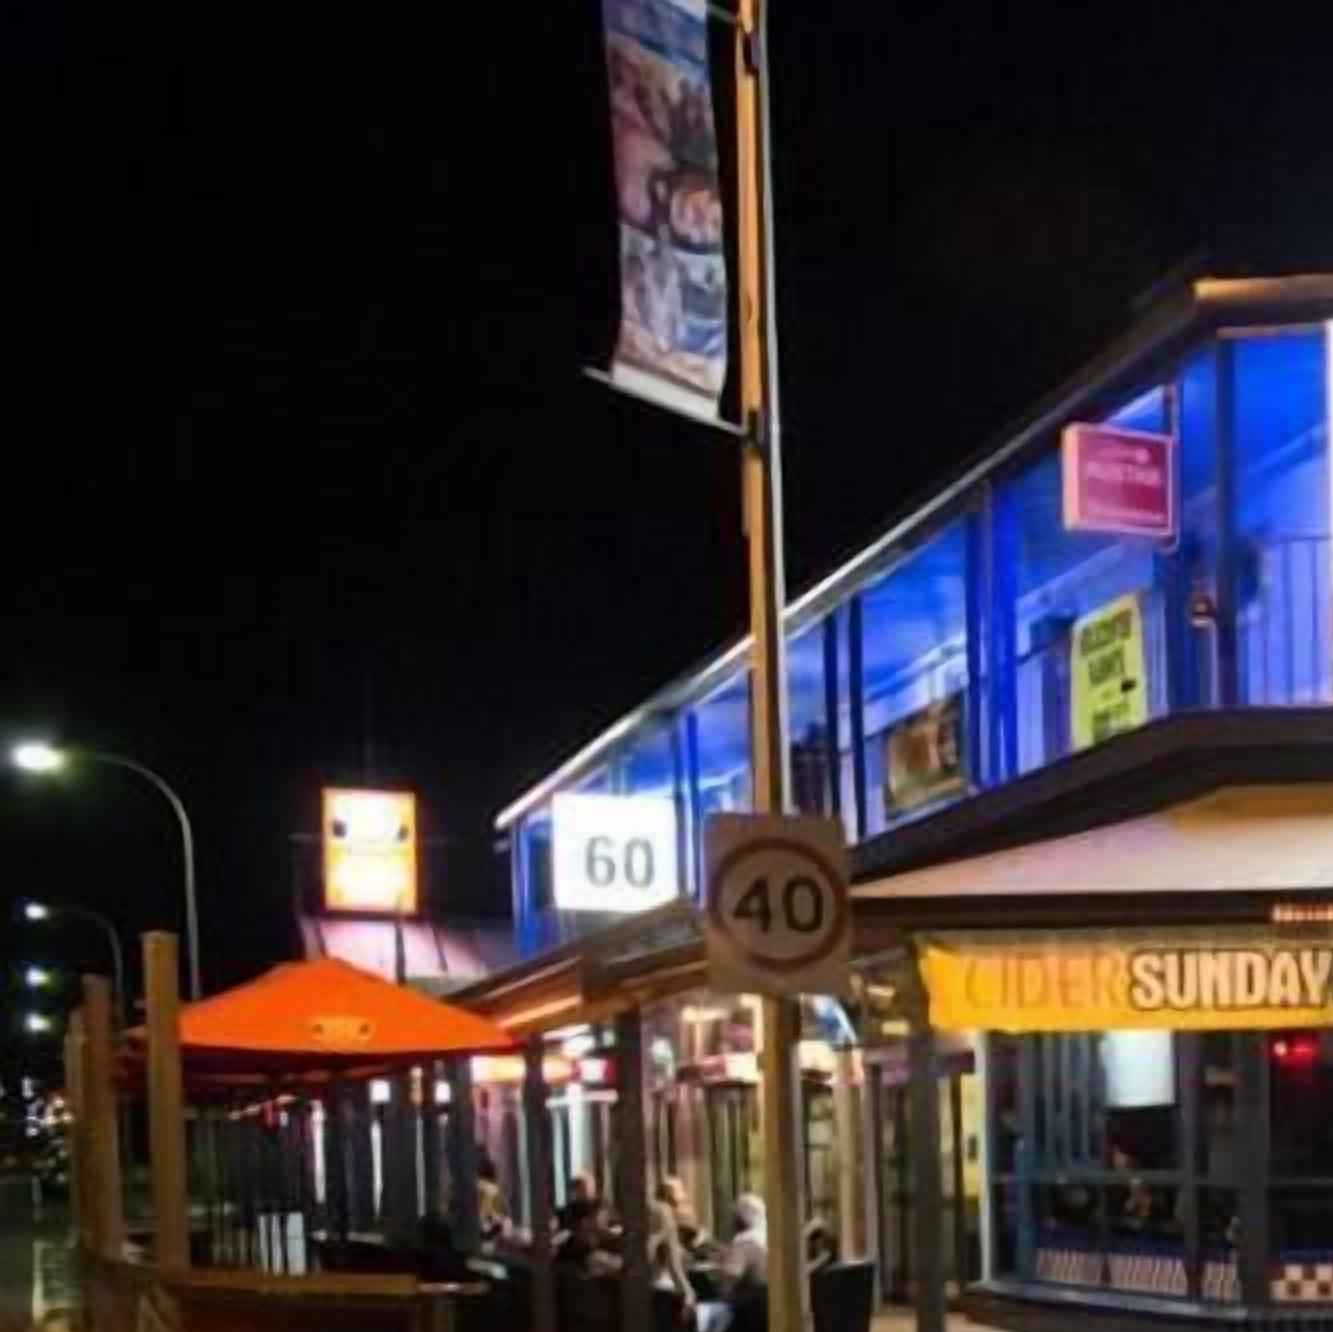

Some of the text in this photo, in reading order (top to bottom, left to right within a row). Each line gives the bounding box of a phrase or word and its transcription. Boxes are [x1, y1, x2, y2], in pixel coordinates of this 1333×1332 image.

[583, 835, 656, 889] 60
[732, 876, 824, 932] 40
[964, 946, 1122, 1010] CIDER
